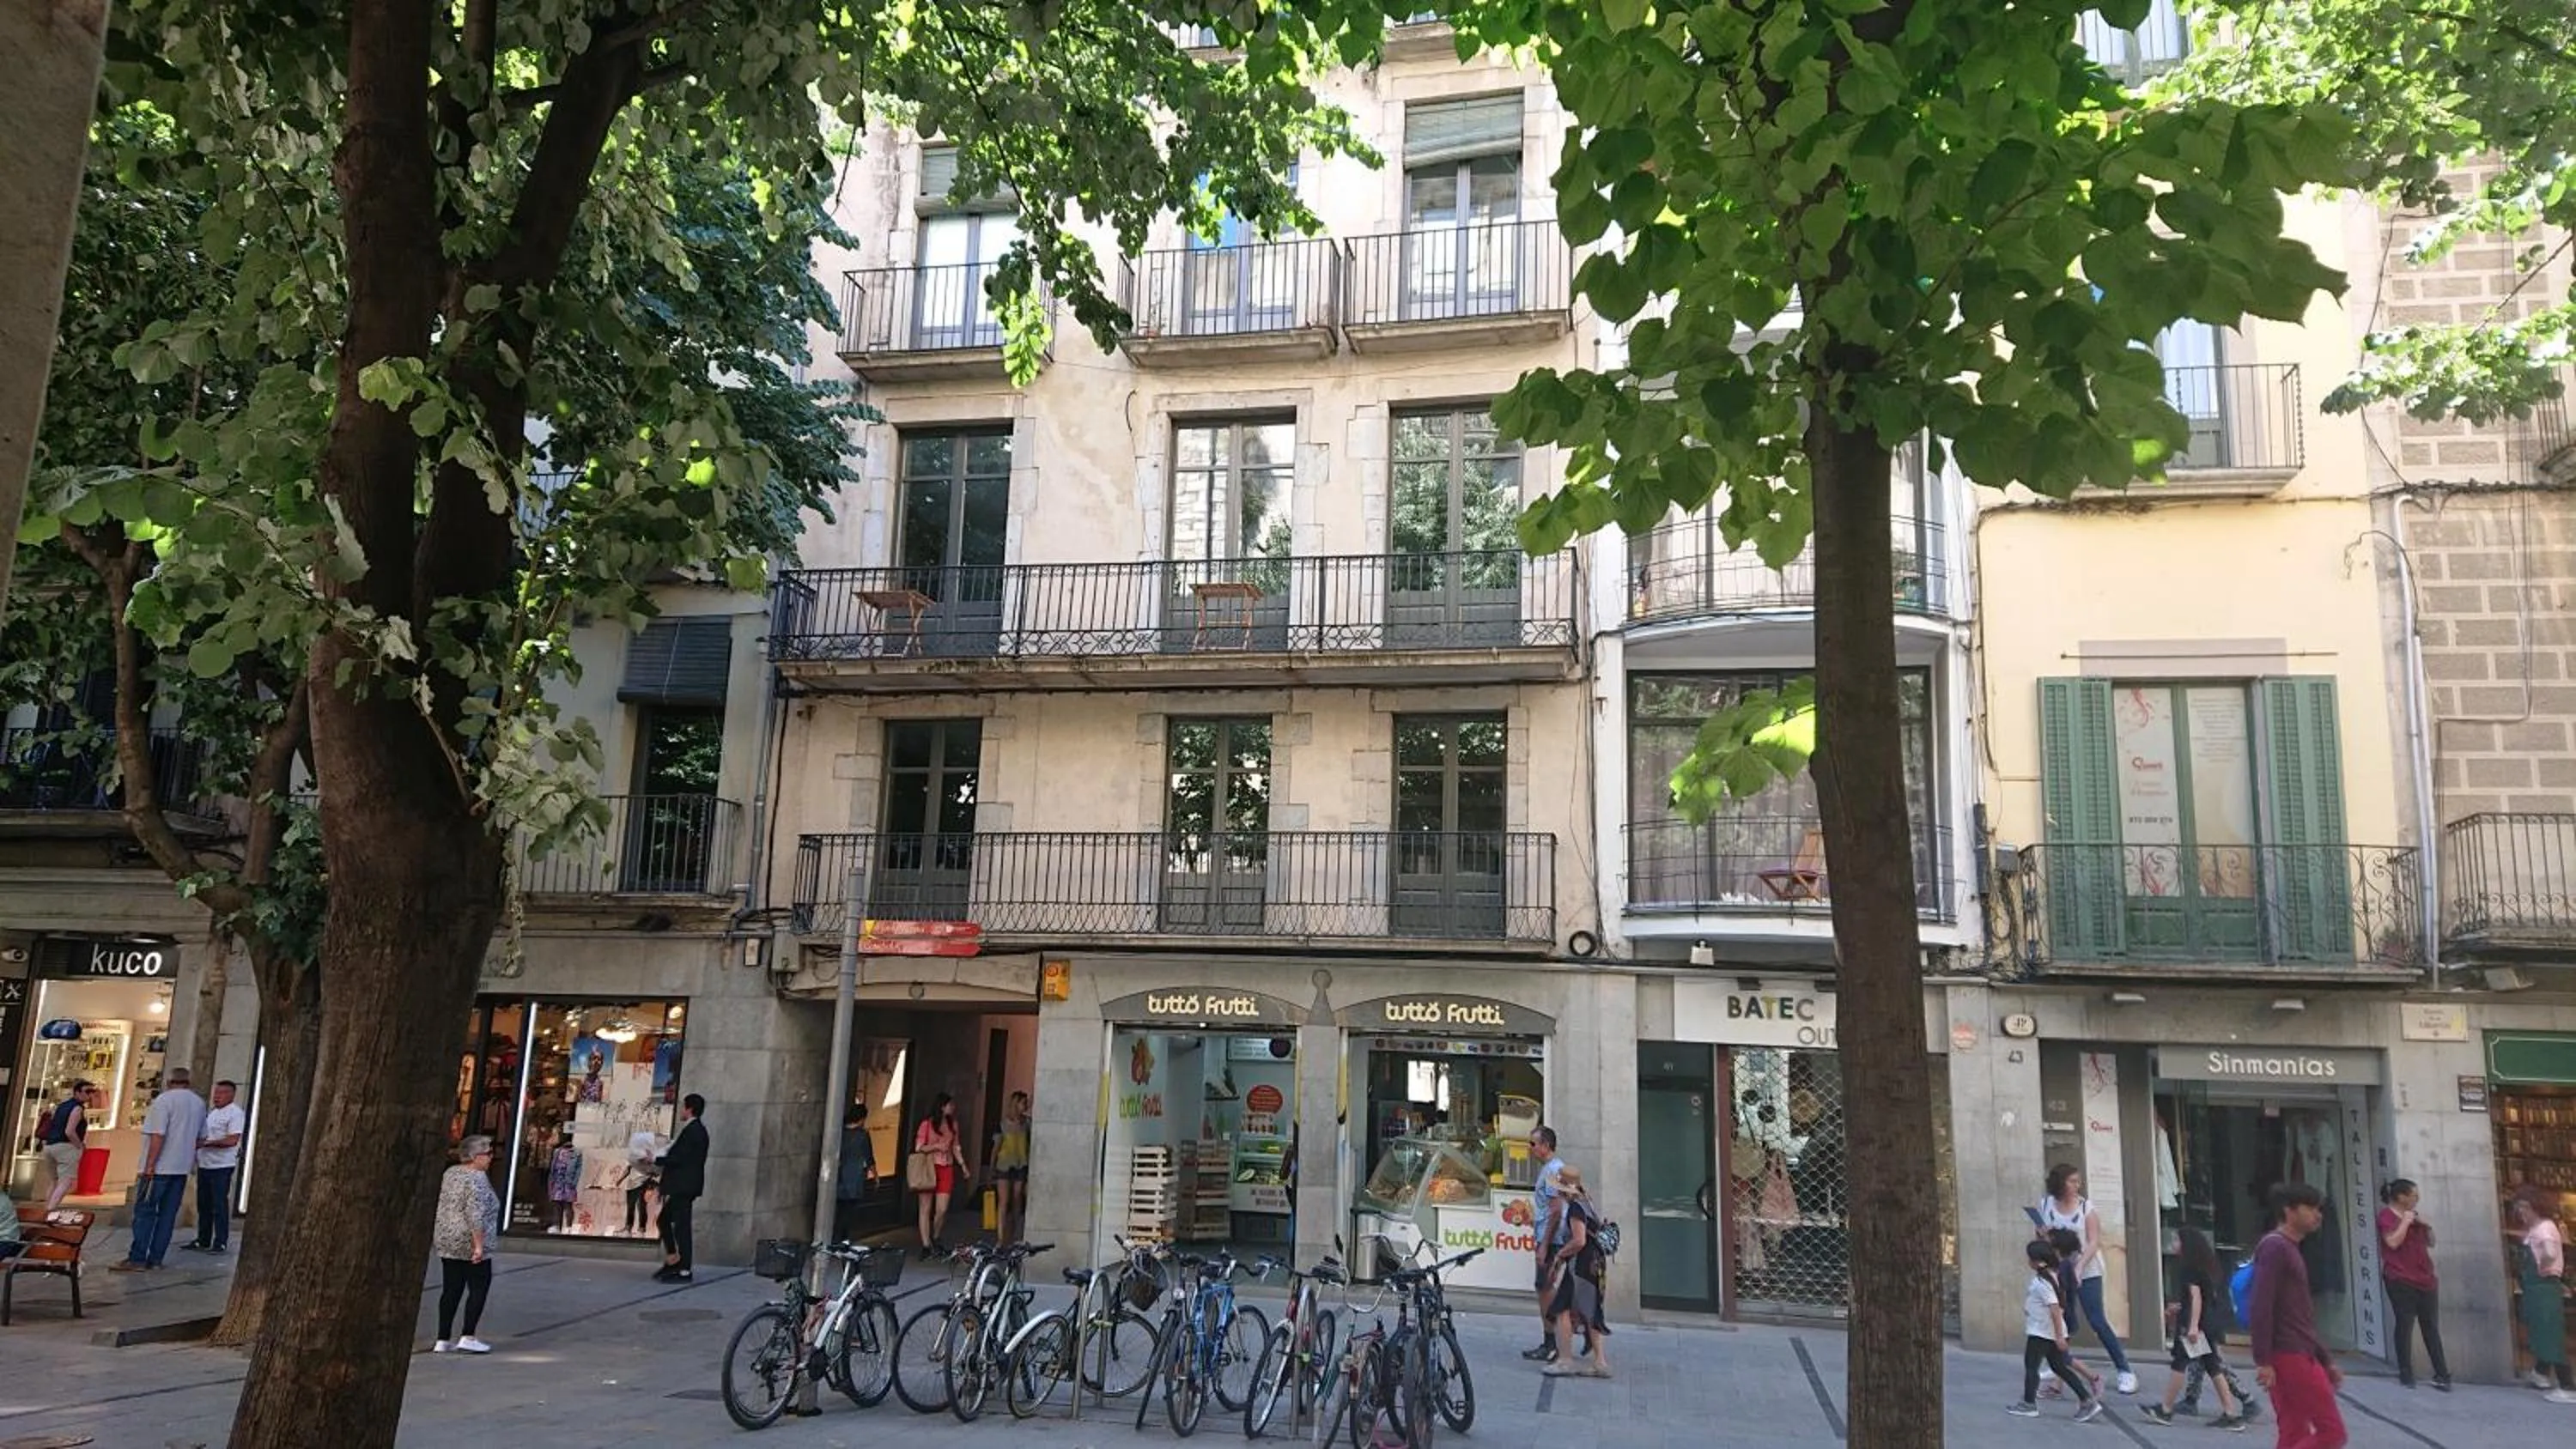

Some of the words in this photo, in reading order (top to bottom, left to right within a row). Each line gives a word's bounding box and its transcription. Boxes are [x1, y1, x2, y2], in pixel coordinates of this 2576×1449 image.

[90, 943, 162, 976] kuco
[1205, 996, 1260, 1016] frutti
[1447, 1003, 1504, 1025] frutti
[1728, 996, 1814, 1022] BATEC
[1797, 1026, 1837, 1046] OUT
[2349, 1108, 2367, 1228] TALLES
[2359, 1245, 2376, 1346] GRANS
